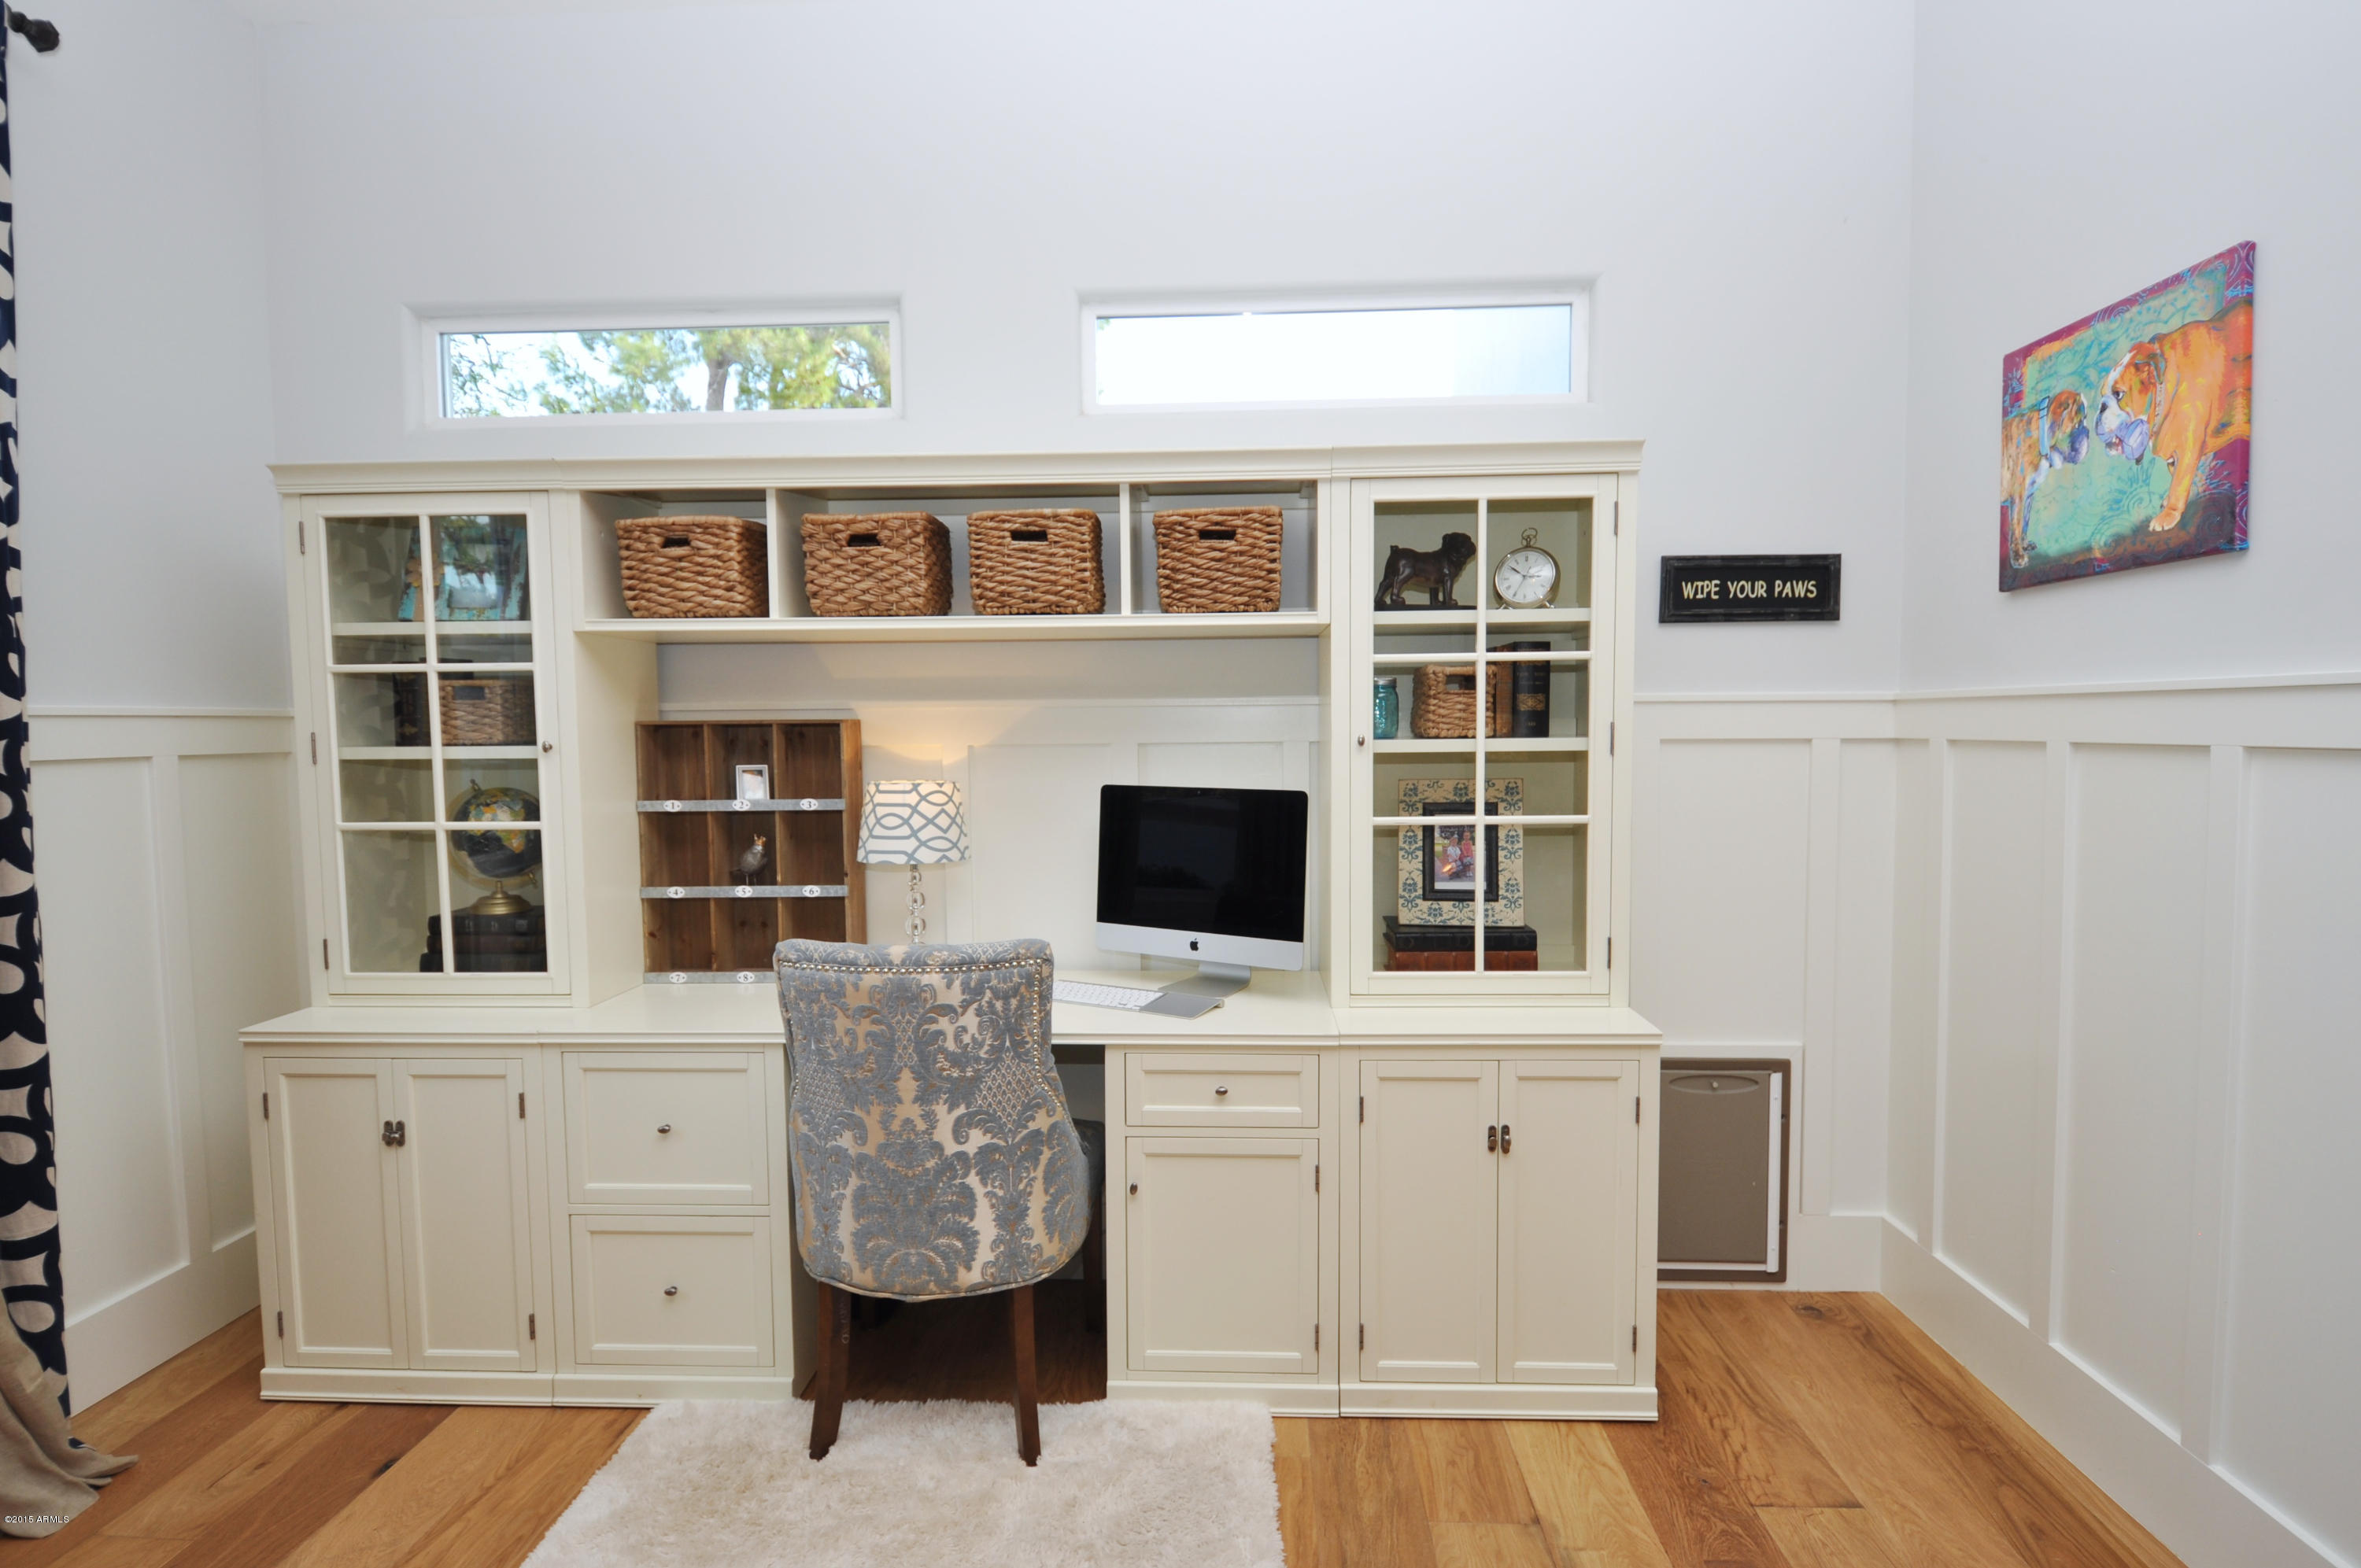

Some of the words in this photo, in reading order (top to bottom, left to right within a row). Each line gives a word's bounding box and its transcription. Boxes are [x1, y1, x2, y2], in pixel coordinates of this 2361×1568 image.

[1682, 580, 1720, 600] WIPE
[1727, 580, 1767, 599] YOUR
[1774, 580, 1817, 598] PAWS
